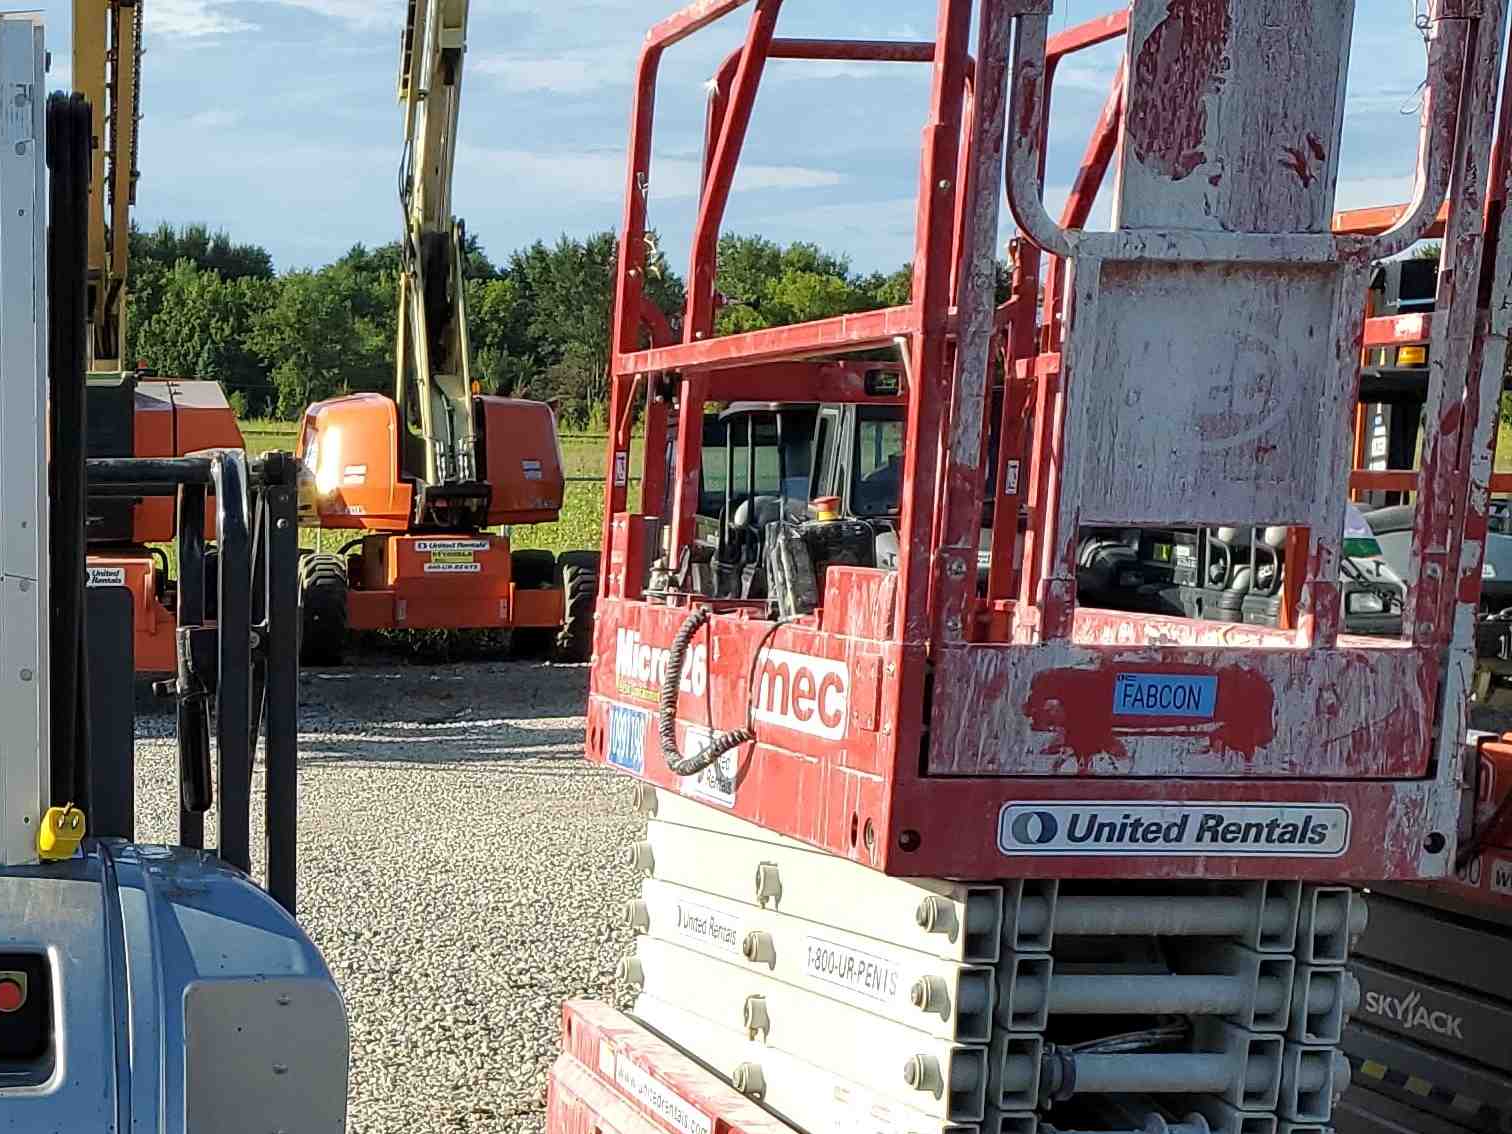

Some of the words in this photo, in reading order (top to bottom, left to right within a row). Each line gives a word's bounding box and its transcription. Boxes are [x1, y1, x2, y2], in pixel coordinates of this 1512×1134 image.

[757, 654, 845, 729] mec
[1122, 683, 1202, 711] FABCON
[1067, 812, 1190, 845] United
[1195, 812, 1329, 845] Rentals
[683, 908, 707, 935] United
[708, 915, 737, 945] Rentals
[1366, 990, 1464, 1039] SKYJACK
